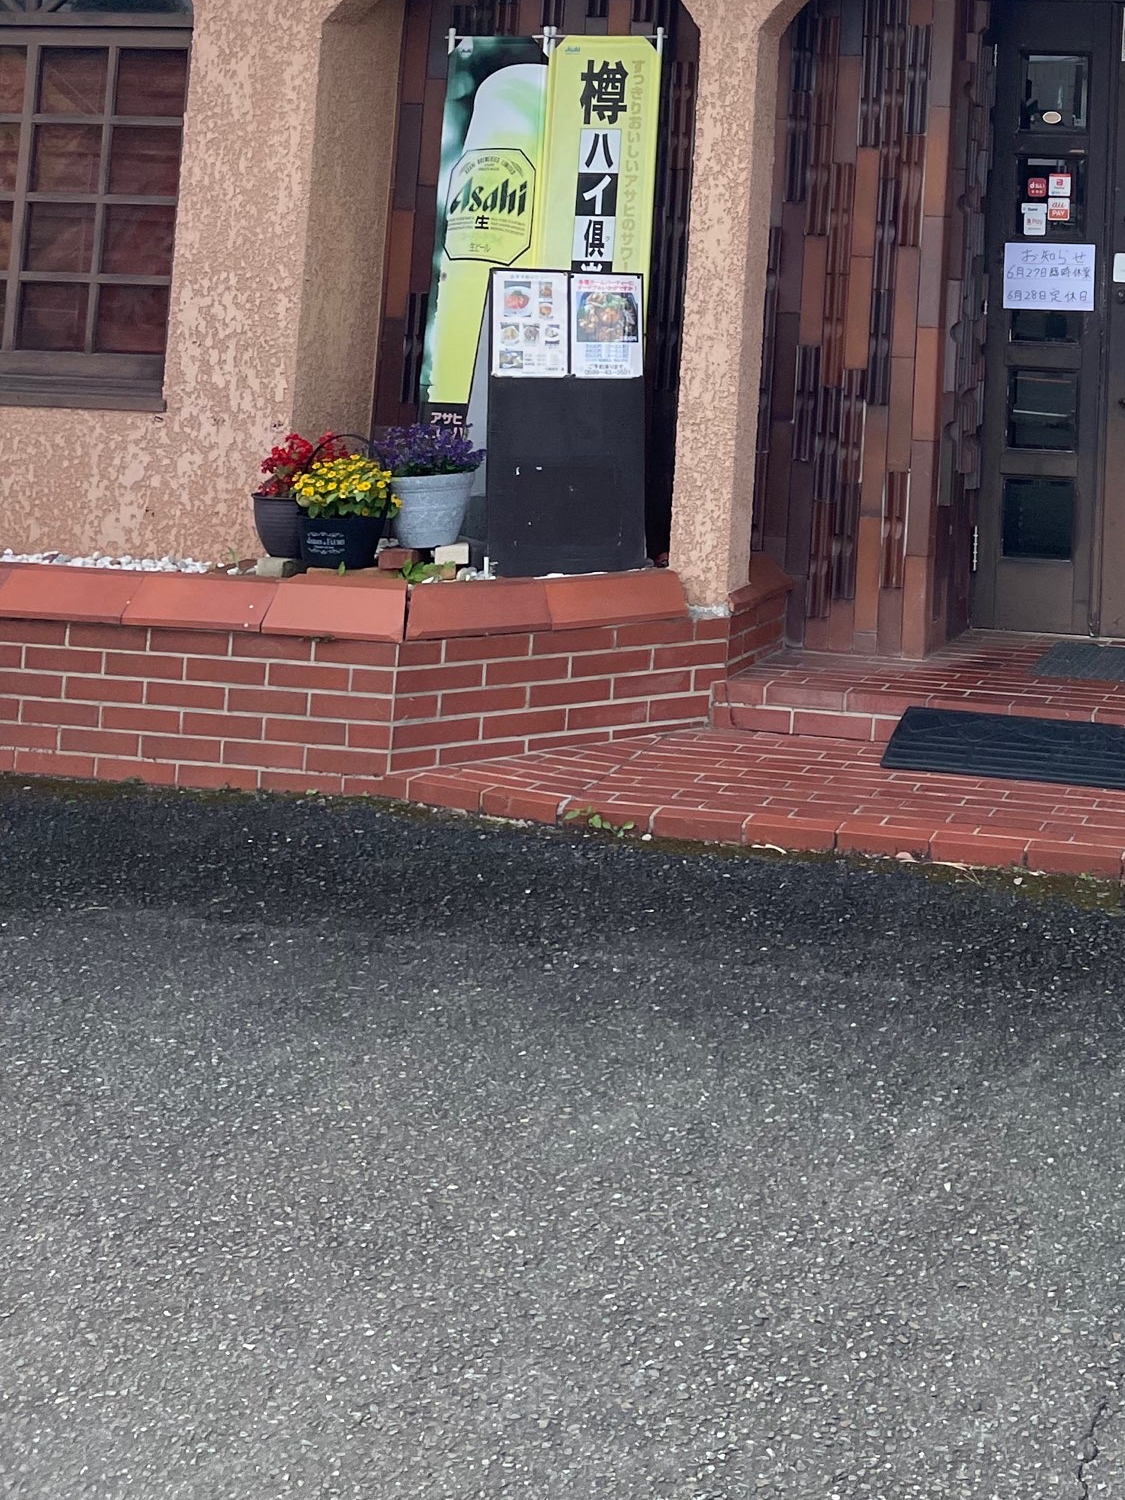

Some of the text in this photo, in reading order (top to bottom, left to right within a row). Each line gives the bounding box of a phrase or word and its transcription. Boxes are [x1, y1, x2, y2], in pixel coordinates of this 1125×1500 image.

[580, 59, 629, 272] 樽ハイ倶
[450, 176, 528, 216] Asahi
[475, 214, 490, 230] 生
[1020, 248, 1087, 265] お知らせ
[430, 412, 463, 425] アサヒ
